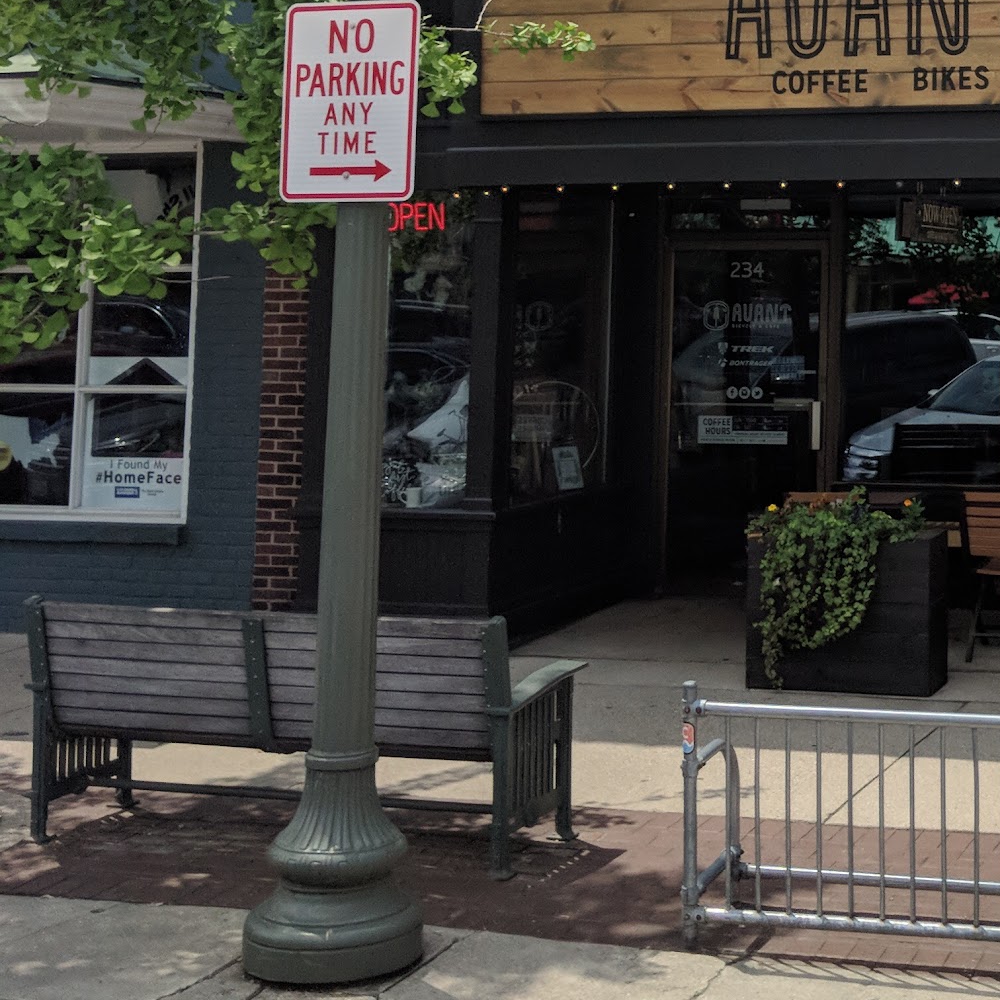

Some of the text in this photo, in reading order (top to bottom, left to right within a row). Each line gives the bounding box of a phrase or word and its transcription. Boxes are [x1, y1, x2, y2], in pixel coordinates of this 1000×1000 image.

[329, 18, 375, 54] NO
[295, 60, 405, 97] PARKING
[772, 65, 990, 94] COFFEE BIKES
[323, 101, 373, 126] ANY
[317, 131, 377, 155] TIME
[730, 261, 765, 279] 234
[730, 345, 775, 353] TREK
[703, 418, 731, 426] COFFEE
[705, 427, 731, 435] HOURS
[117, 459, 150, 470] Found
[153, 460, 168, 472] My
[96, 470, 182, 484] #HomeFace
